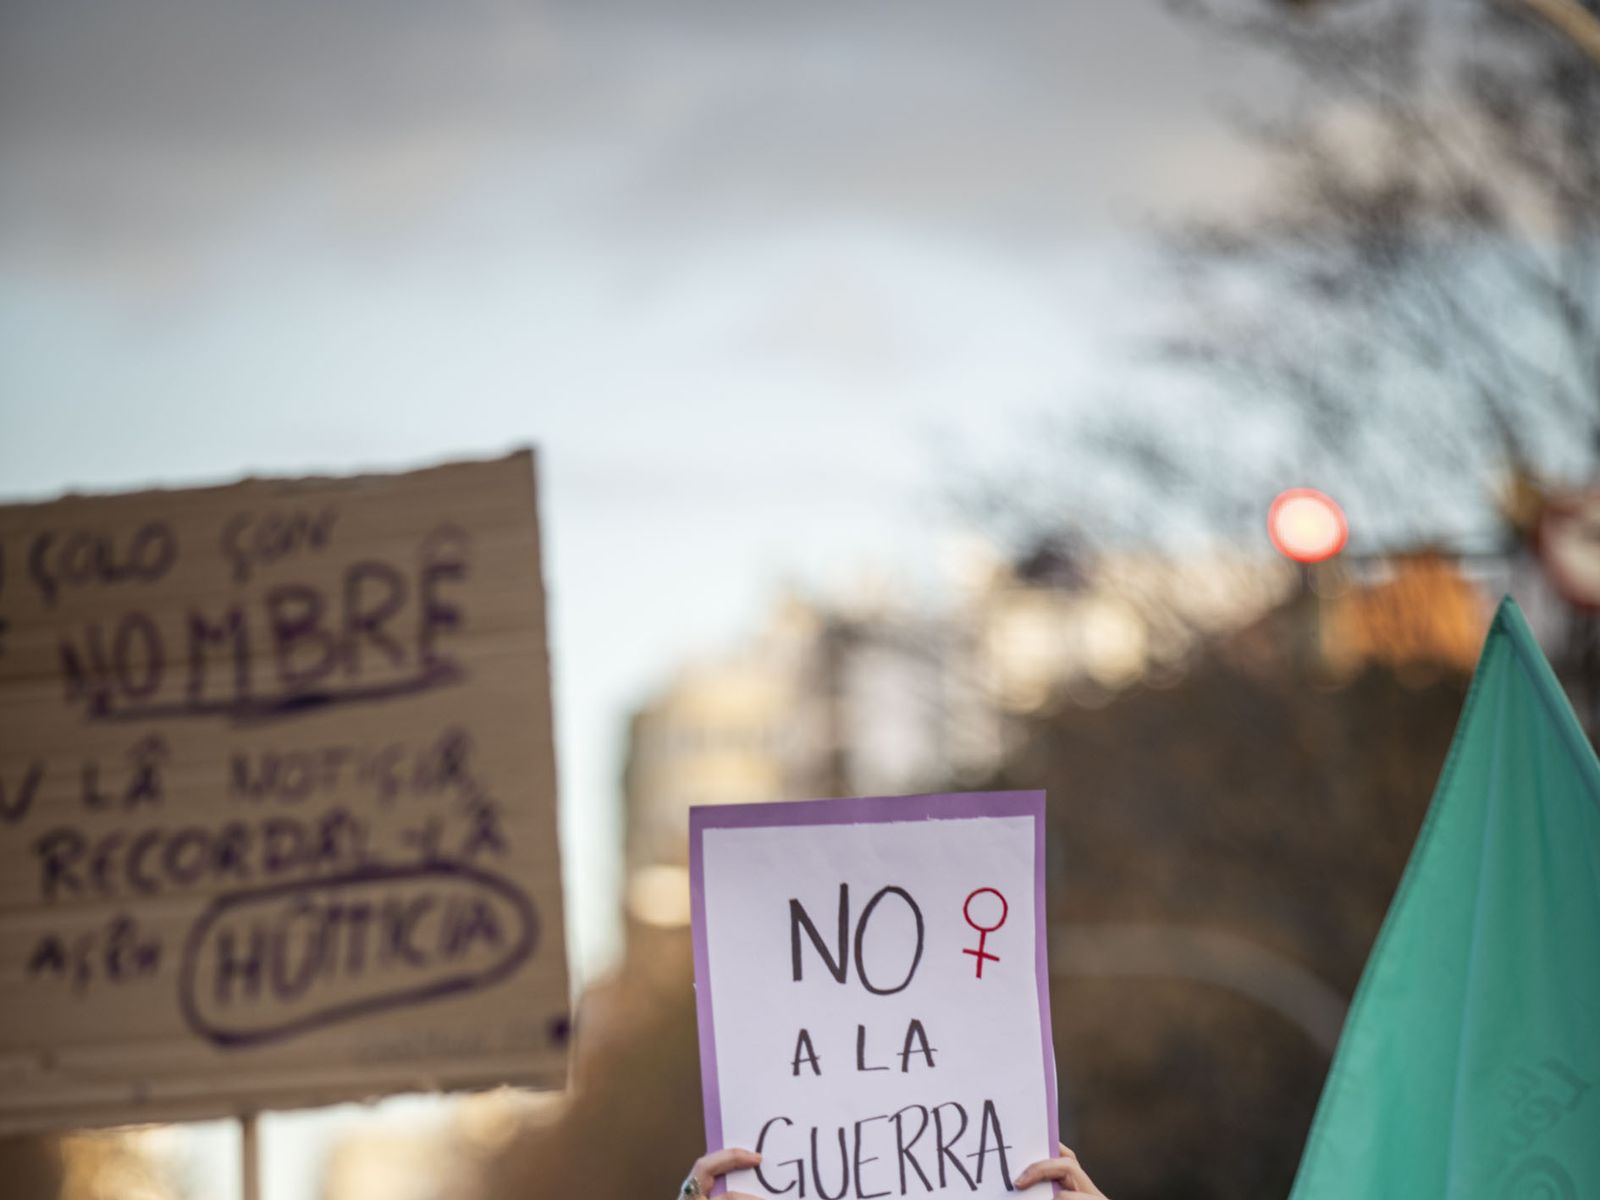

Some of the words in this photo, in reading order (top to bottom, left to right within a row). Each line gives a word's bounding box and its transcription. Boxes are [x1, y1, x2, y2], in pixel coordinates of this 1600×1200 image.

[788, 882, 925, 996] NO
[791, 1028, 822, 1077] A
[856, 1018, 938, 1074] LA
